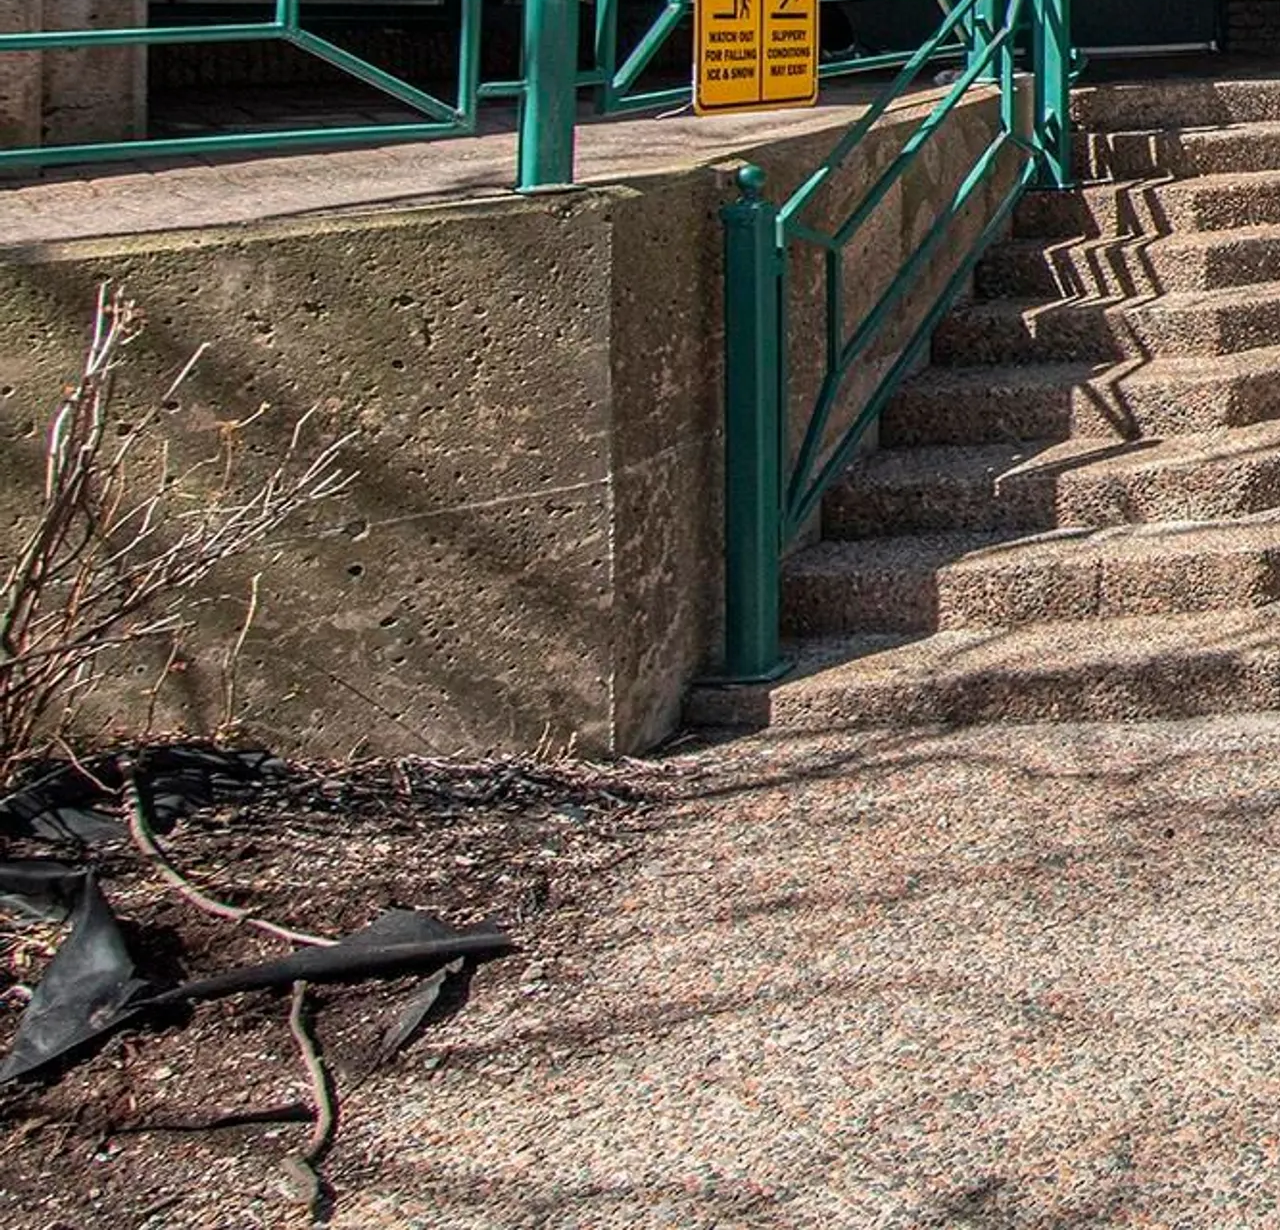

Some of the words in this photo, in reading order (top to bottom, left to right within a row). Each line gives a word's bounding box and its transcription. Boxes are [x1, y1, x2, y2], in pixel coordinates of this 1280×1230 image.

[709, 31, 737, 43] WATCH
[739, 30, 754, 42] OUT
[771, 30, 807, 42] SLIPPERY
[705, 49, 723, 61] FOR
[724, 49, 757, 61] FALLING
[767, 47, 810, 59] CONDITIONS
[706, 68, 721, 80] ICE
[731, 67, 754, 79] SNOW
[770, 64, 786, 76] MAY
[787, 63, 807, 76] EXIST
